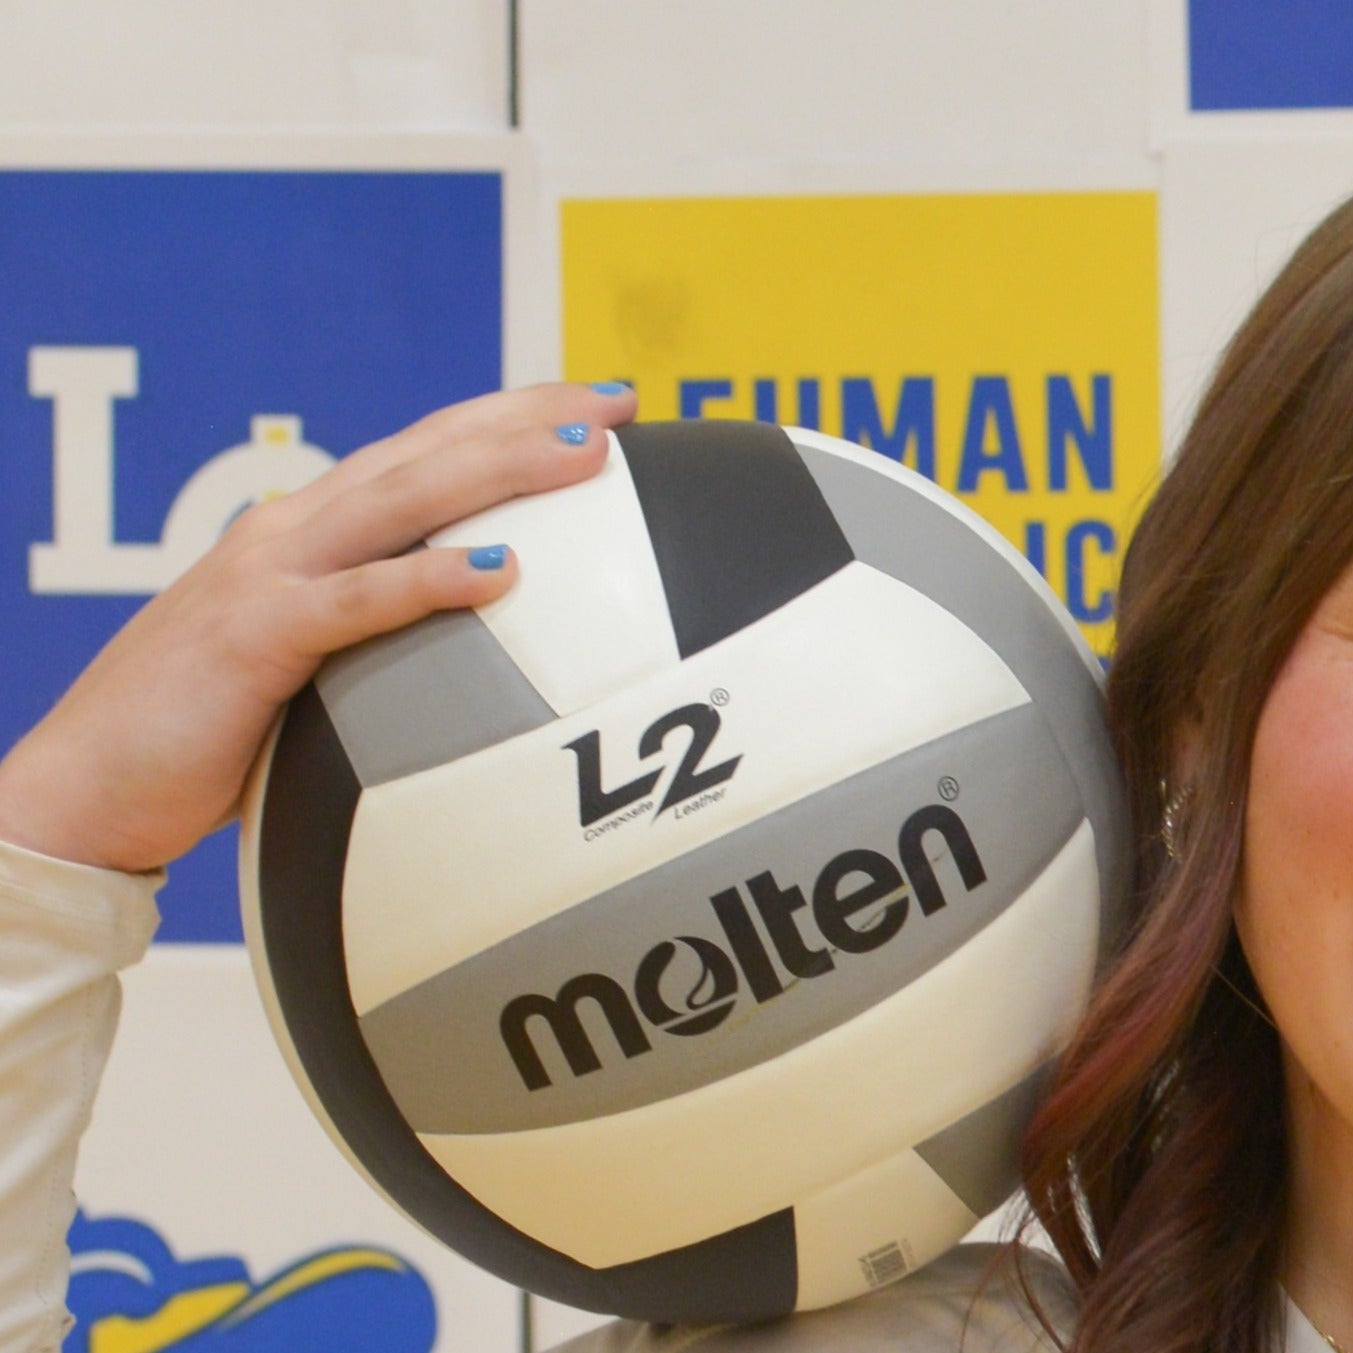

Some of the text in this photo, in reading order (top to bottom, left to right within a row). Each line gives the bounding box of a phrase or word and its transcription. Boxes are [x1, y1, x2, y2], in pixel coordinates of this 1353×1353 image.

[561, 702, 744, 826] L2
[583, 787, 728, 842] Composite Leather
[500, 803, 987, 1092] molten
